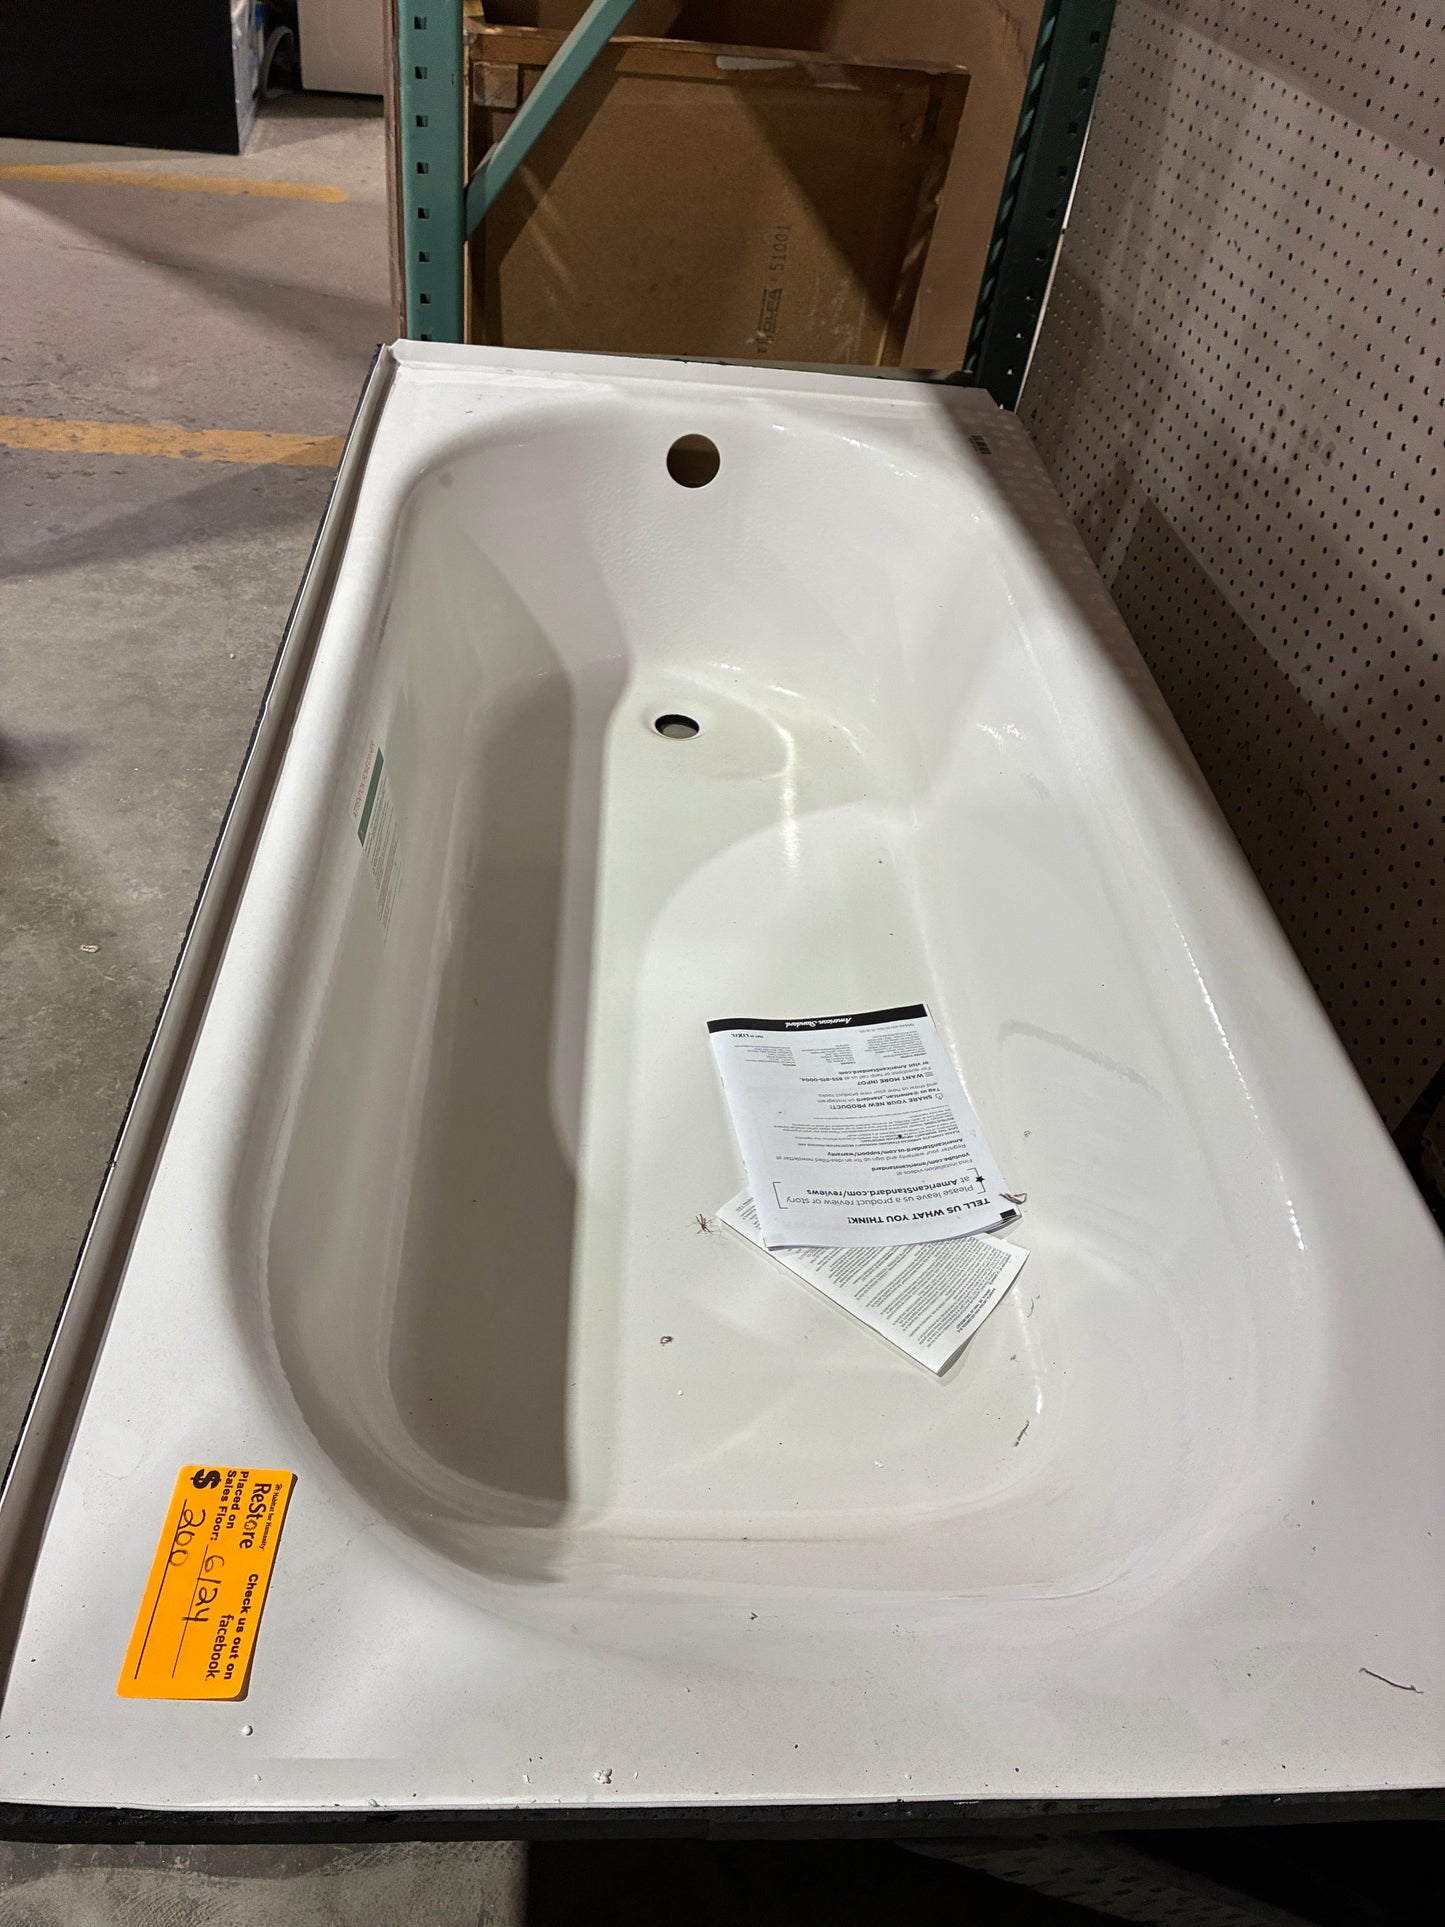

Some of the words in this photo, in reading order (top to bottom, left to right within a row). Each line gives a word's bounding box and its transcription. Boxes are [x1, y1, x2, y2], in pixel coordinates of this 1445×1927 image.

[785, 1020, 817, 1028] Standard
[818, 1017, 852, 1025] American
[941, 1144, 966, 1152] Register
[925, 1162, 957, 1172] installation
[806, 1179, 957, 1198] AmericanStandard.com/reviews
[943, 1185, 974, 1196] Please
[786, 1196, 810, 1205] story
[856, 1196, 894, 1206] product
[916, 1192, 941, 1202] leave
[963, 1198, 990, 1209] TELL
[912, 1208, 944, 1220] WHAT
[946, 1205, 962, 1214] US
[847, 1216, 884, 1224] THINK!
[886, 1214, 910, 1223] YOU
[190, 1469, 222, 1489] $
[221, 1470, 237, 1502] Sales
[231, 1471, 249, 1510] Placed
[269, 1492, 279, 1512] Habitat
[210, 1506, 228, 1541] Floor:
[226, 1514, 236, 1529] on
[239, 1483, 272, 1549] ReStore
[169, 1509, 206, 1567] 200
[259, 1522, 272, 1550] Humanity
[240, 1574, 259, 1614] Check
[236, 1618, 246, 1633] us
[229, 1637, 242, 1659] out
[224, 1663, 234, 1680] on
